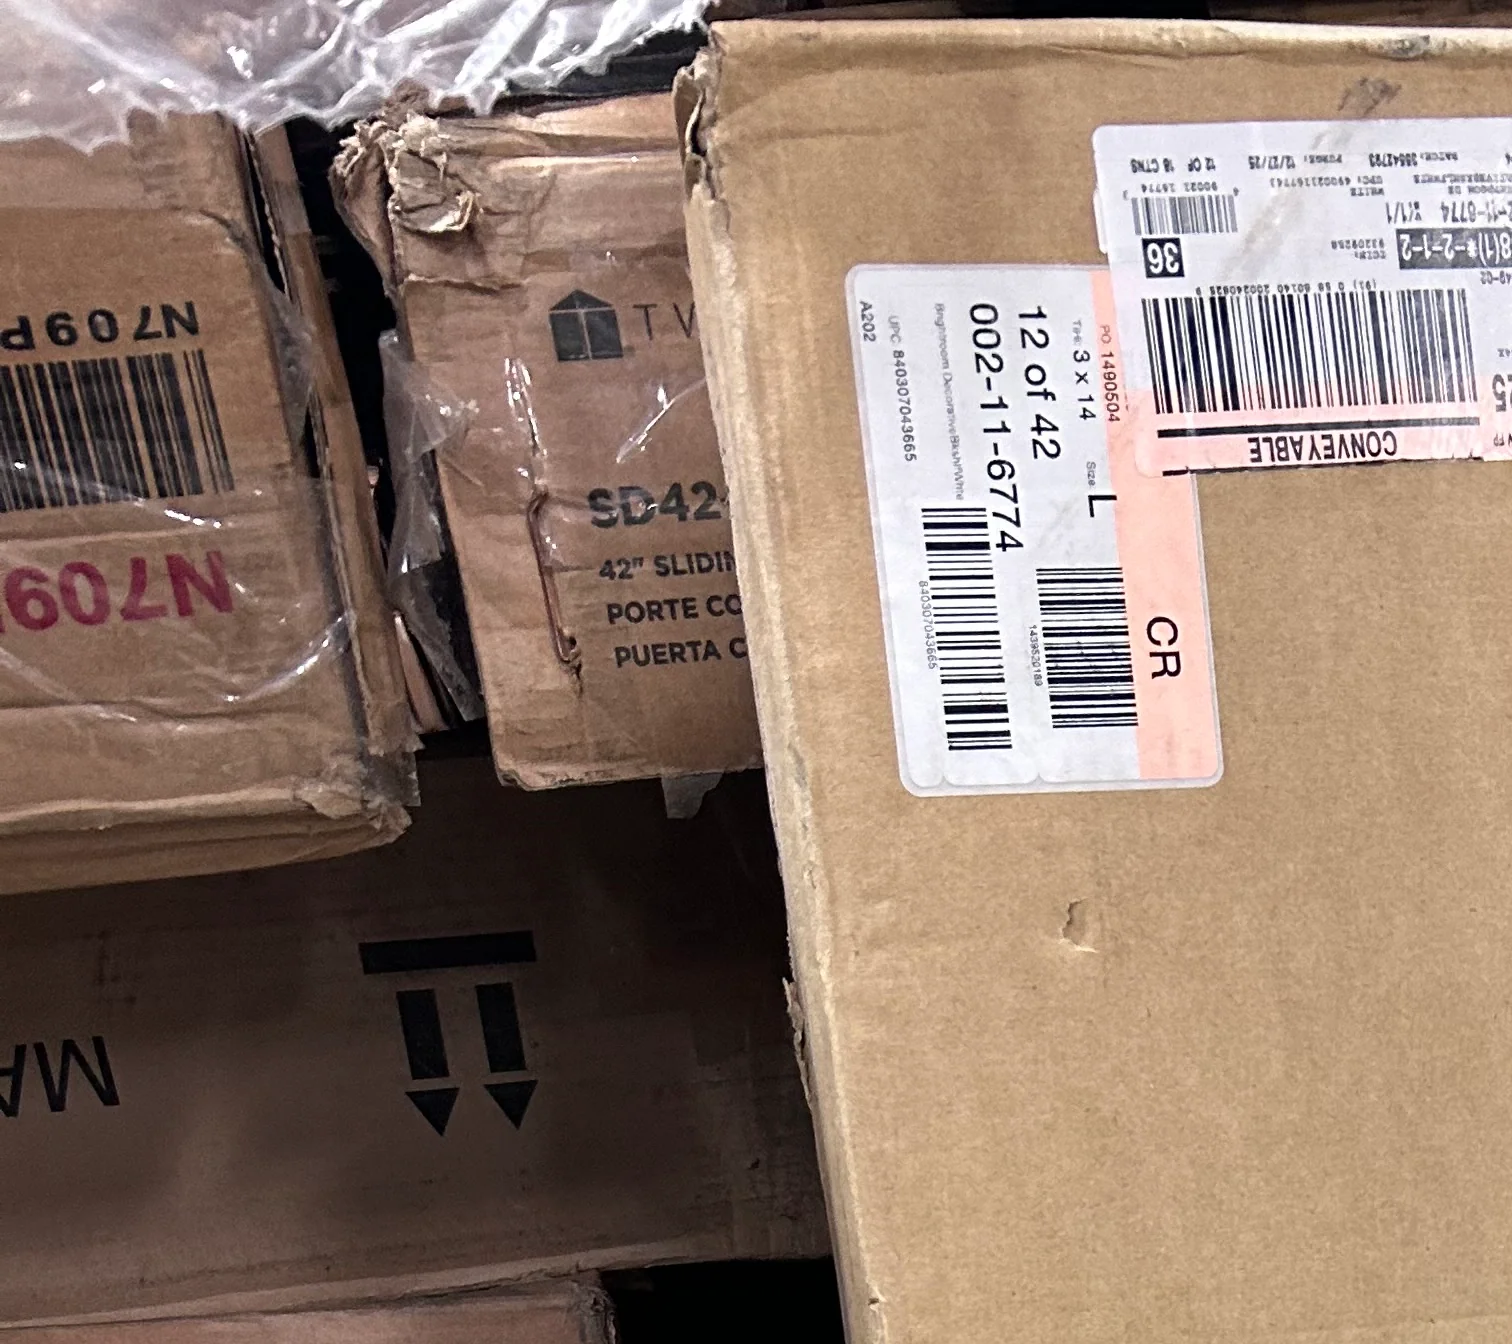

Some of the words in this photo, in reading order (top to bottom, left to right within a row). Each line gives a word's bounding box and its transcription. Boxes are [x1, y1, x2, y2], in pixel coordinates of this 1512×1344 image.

[1146, 242, 1180, 275] 36
[0, 301, 199, 350] N709P
[860, 301, 877, 342] A202
[1018, 305, 1050, 350] 12
[1073, 350, 1091, 363] 3
[1024, 364, 1057, 401] of
[1101, 351, 1120, 423] 1490504
[893, 350, 917, 462] 840307043665
[1078, 394, 1097, 421] 14
[969, 303, 1024, 553] 002-11-6774
[1030, 414, 1062, 460] 42
[1246, 430, 1398, 463] CONVEYABLE
[587, 482, 729, 530] SD42
[1087, 495, 1118, 518] L
[600, 559, 643, 581] 42"
[0, 551, 233, 633] N709
[608, 598, 699, 626] PORTE
[615, 641, 720, 669] PUERTA
[1147, 616, 1182, 680] CR
